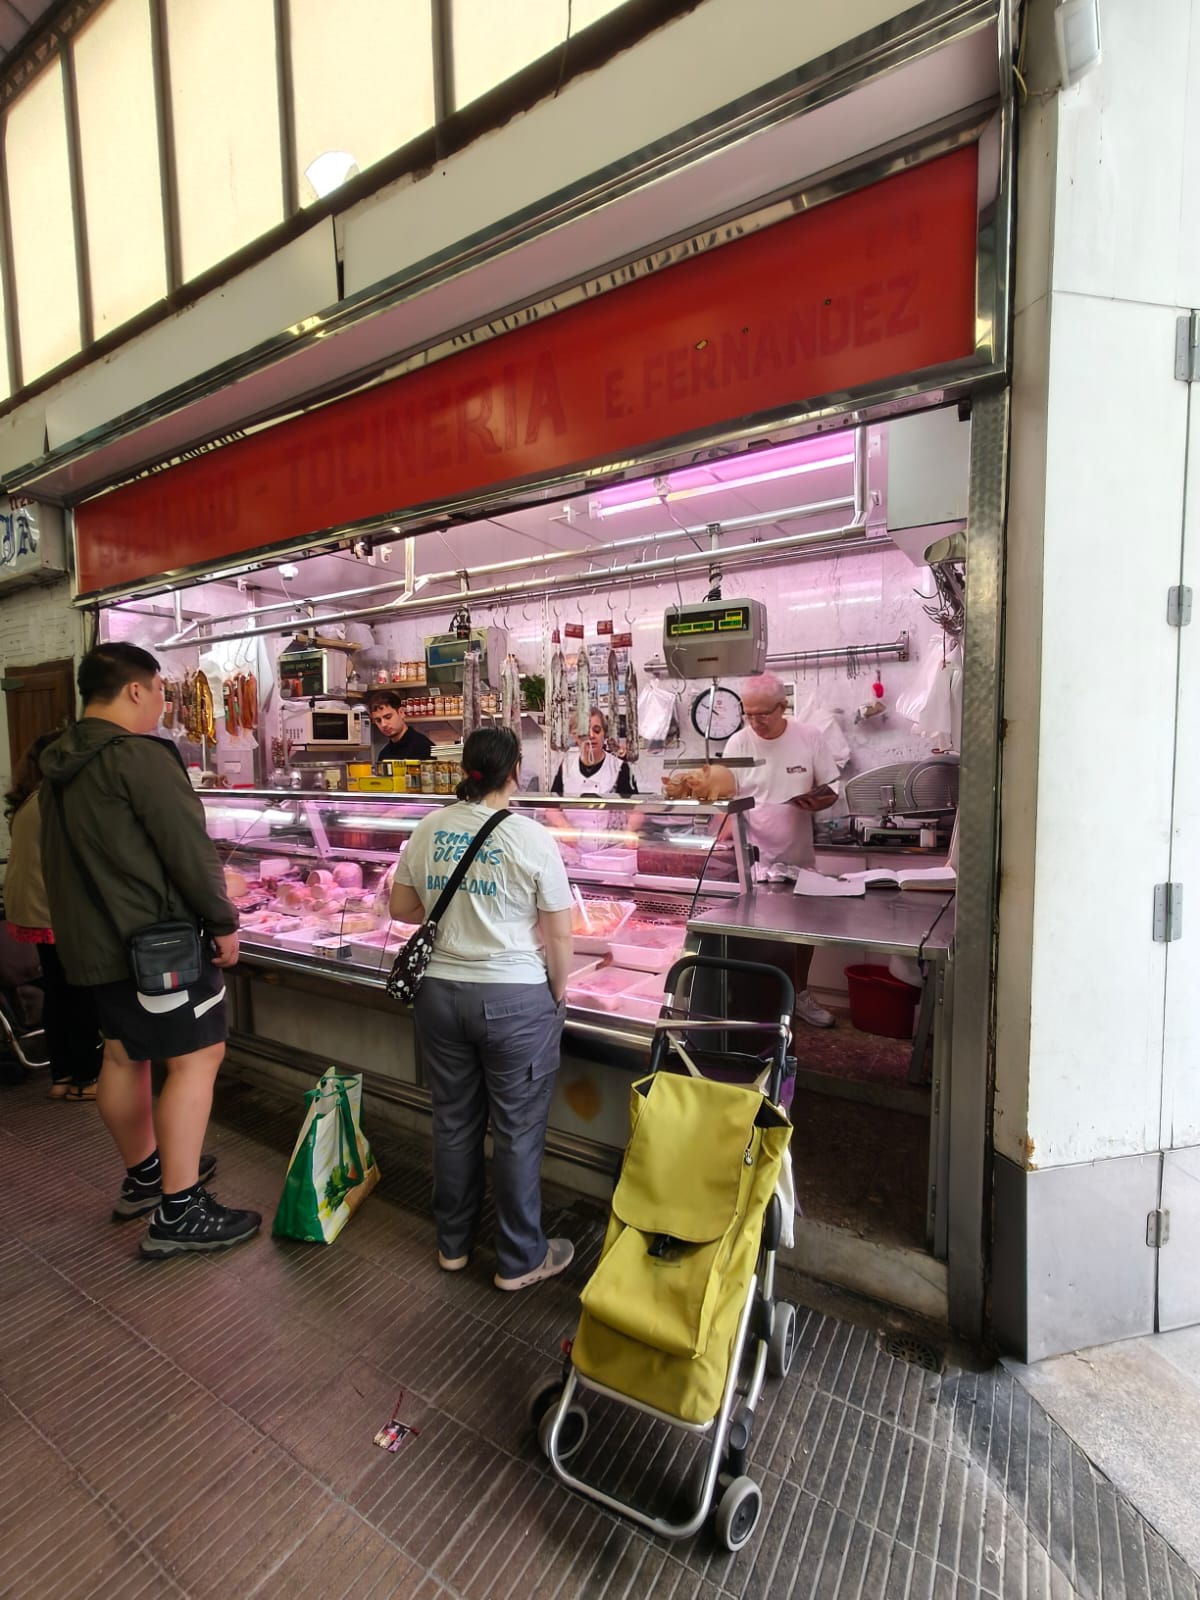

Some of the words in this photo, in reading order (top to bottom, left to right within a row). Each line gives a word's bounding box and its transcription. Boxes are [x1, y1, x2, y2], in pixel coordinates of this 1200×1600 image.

[286, 349, 566, 514] TOCINERIA
[433, 846, 504, 865] OCENS
[427, 875, 497, 896] BARELONA
